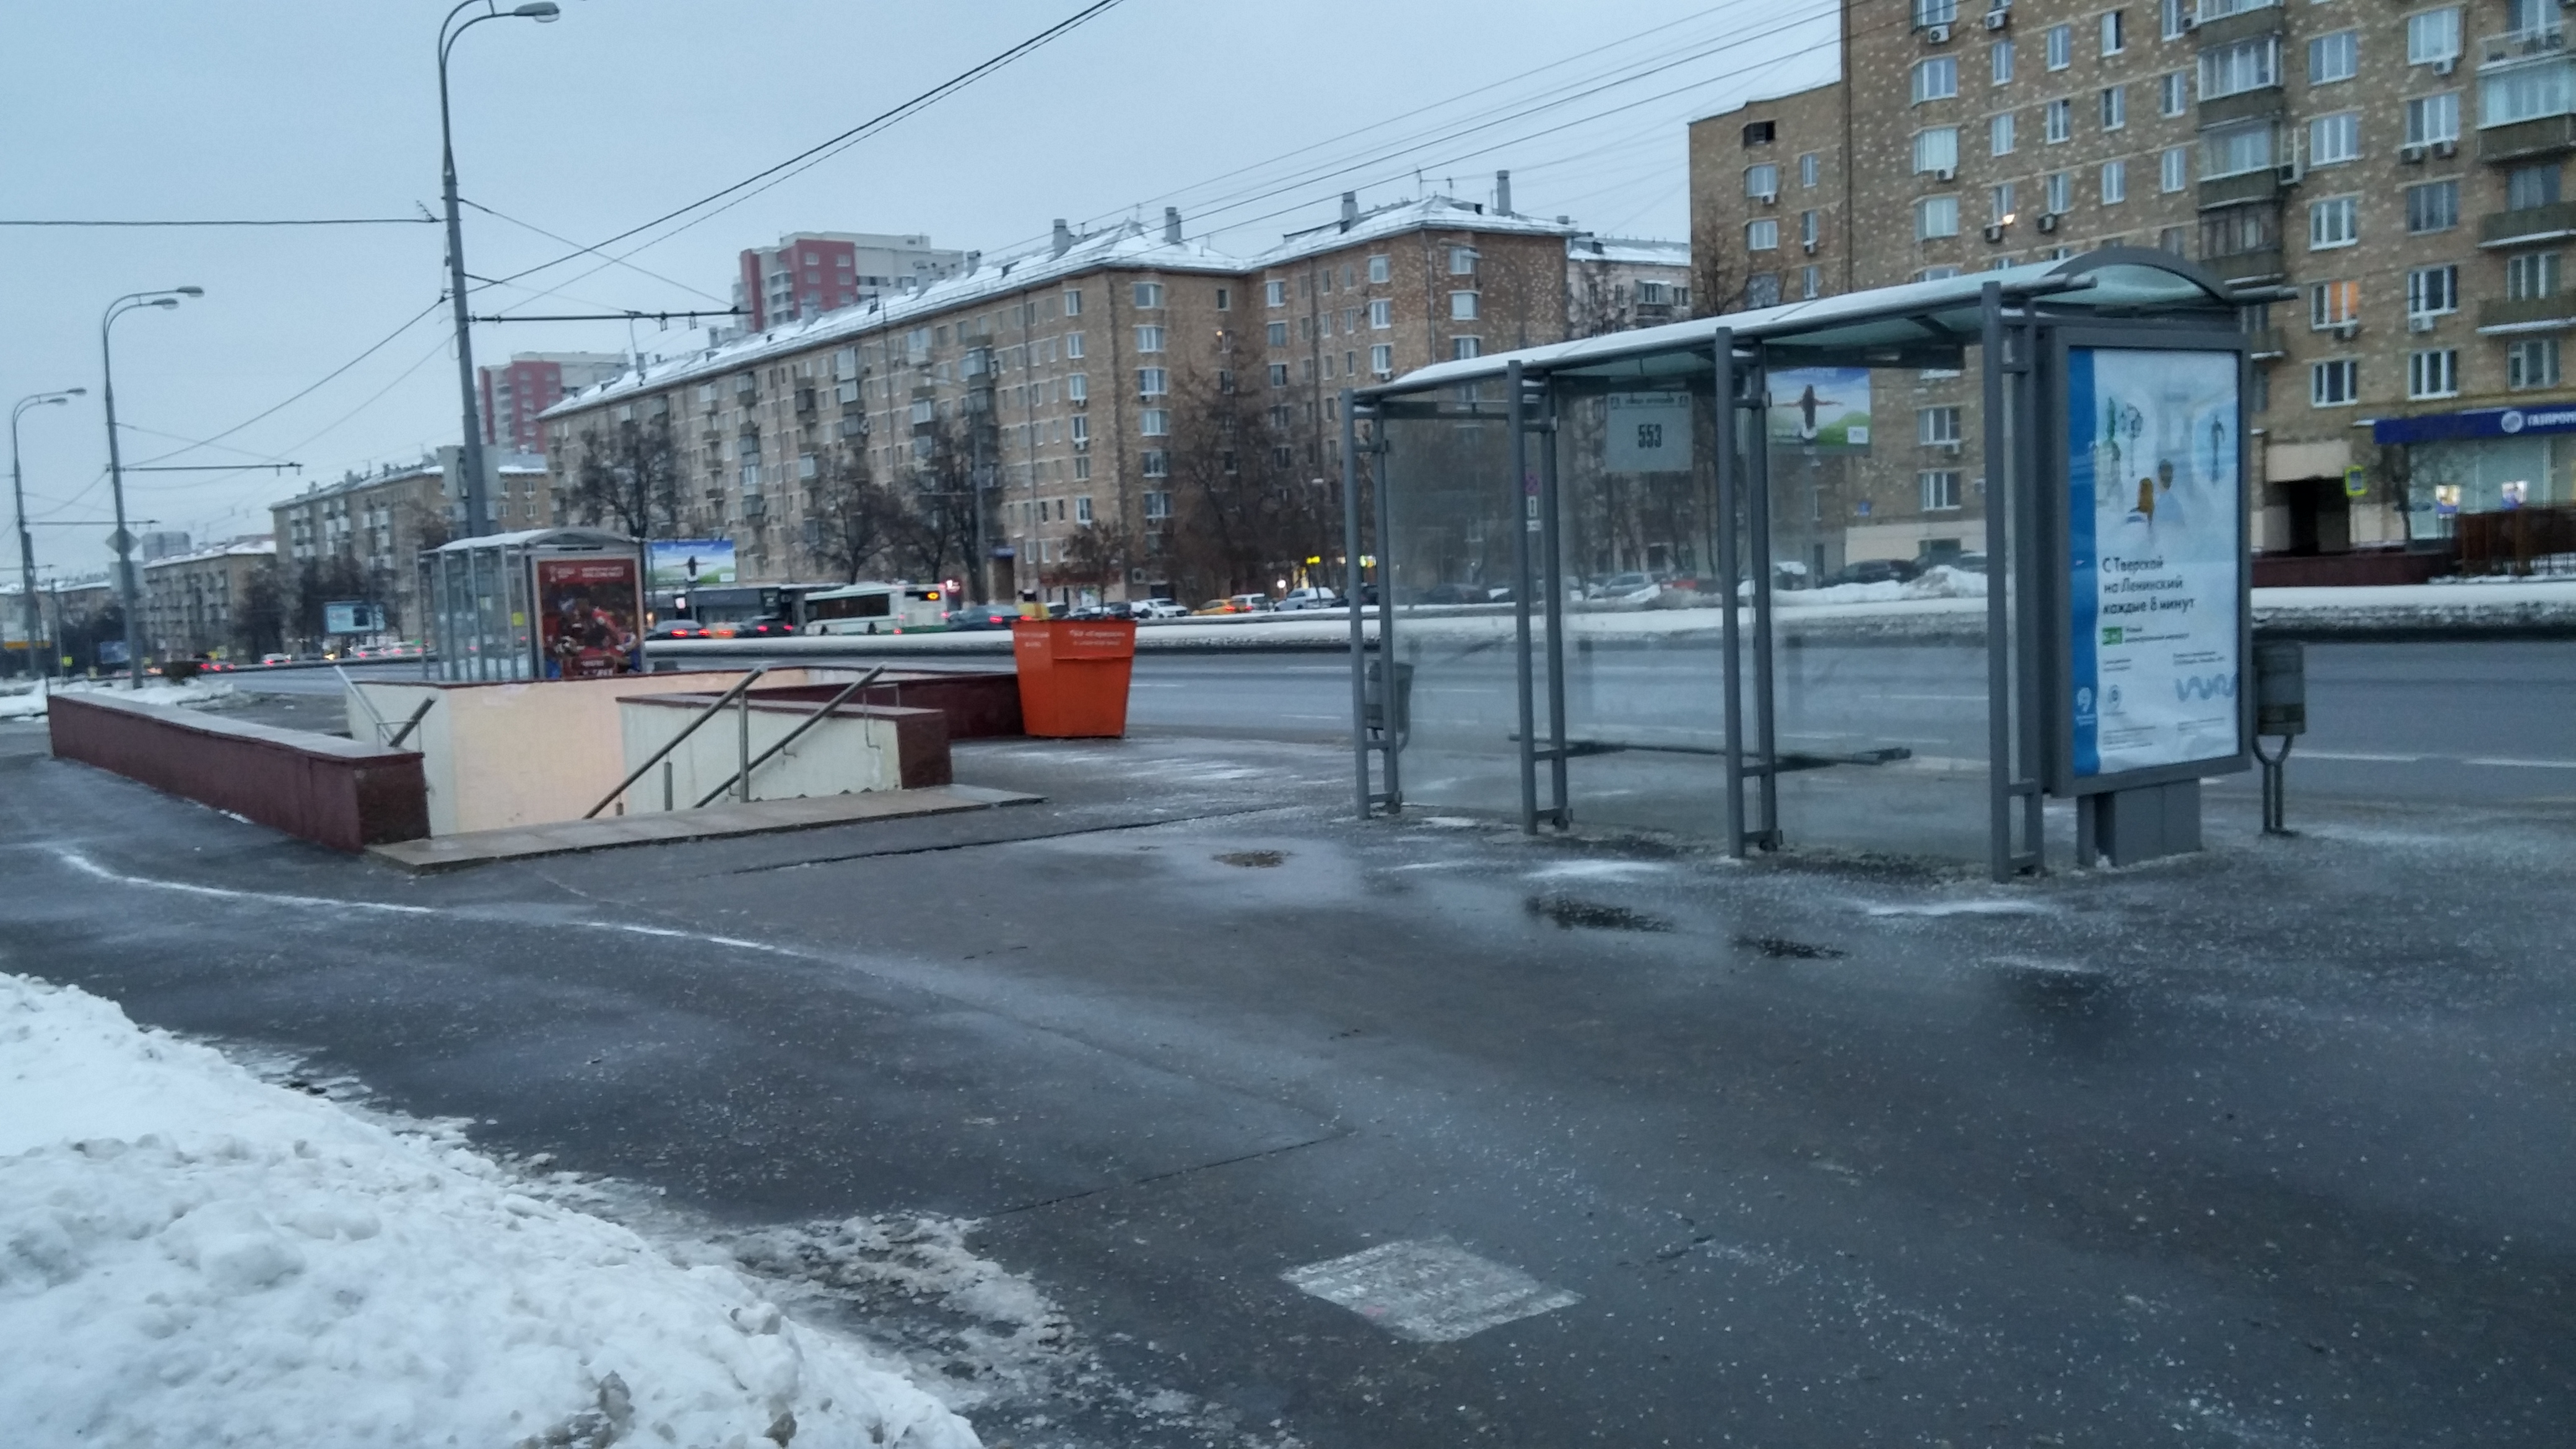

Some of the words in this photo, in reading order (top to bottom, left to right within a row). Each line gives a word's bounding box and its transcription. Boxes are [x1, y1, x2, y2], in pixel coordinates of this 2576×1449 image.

[1638, 424, 1662, 448] 553
[2102, 557, 2111, 573] С
[2113, 555, 2164, 574] Тверской
[2104, 583, 2118, 594] на
[2121, 575, 2183, 593] Ленинский
[2104, 601, 2147, 614] каждые
[2151, 596, 2157, 611] 8
[2160, 598, 2195, 614] минут
